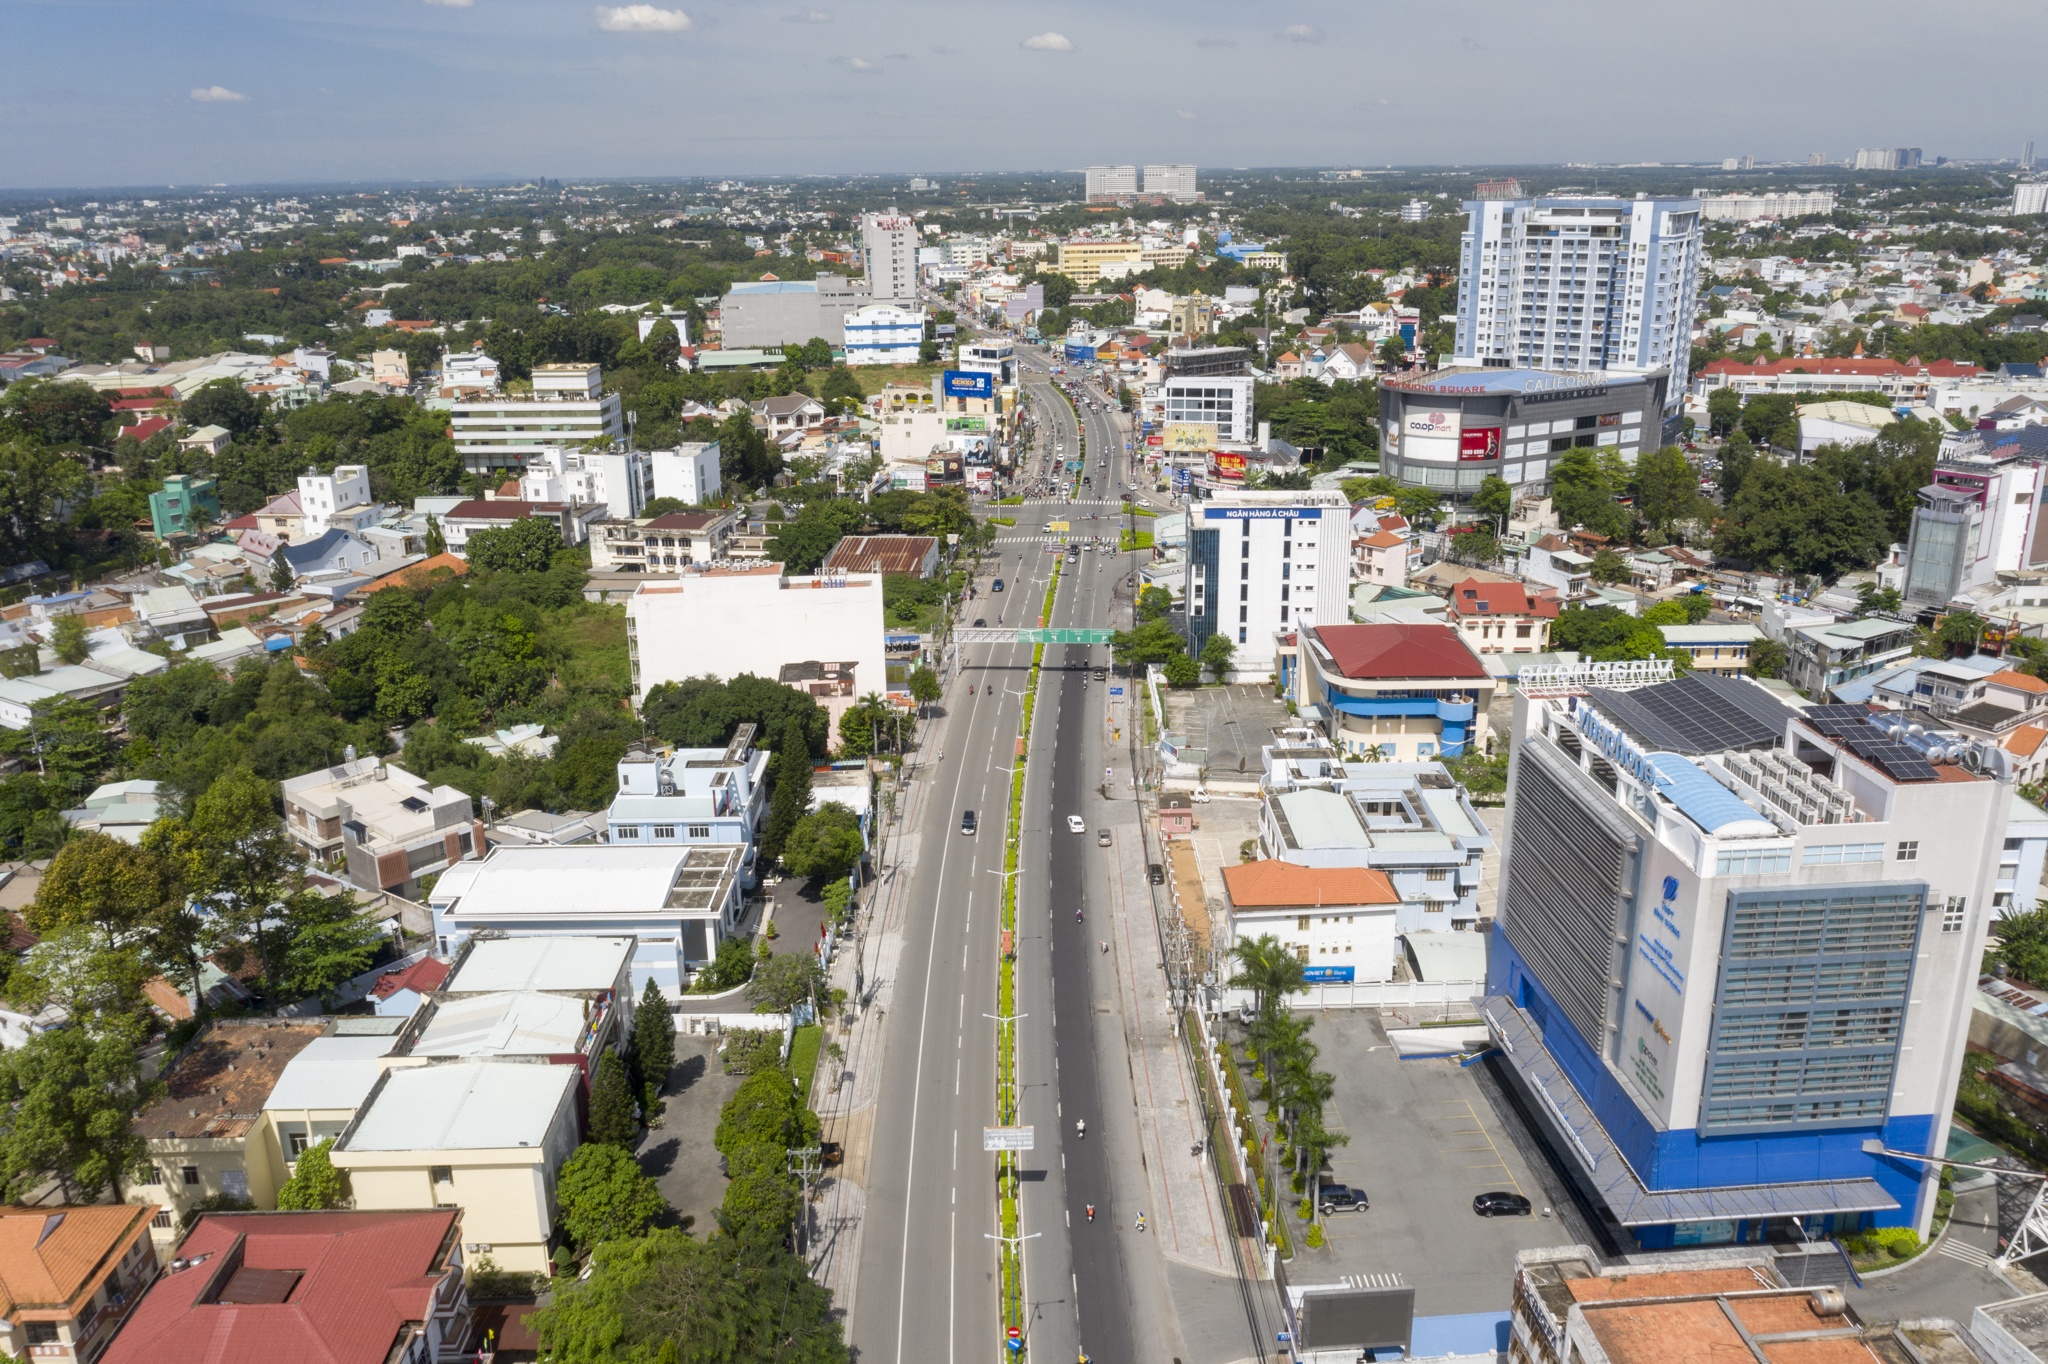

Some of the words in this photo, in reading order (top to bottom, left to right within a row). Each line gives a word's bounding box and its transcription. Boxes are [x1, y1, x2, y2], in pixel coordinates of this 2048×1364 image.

[1525, 372, 1608, 392] CALIFORNIA
[1440, 385, 1486, 393] SQUARE
[1226, 509, 1248, 517] NGÂN
[1272, 509, 1277, 517] Á
[1278, 509, 1299, 517] CHÂU
[823, 579, 846, 588] SHB
[1578, 706, 1657, 787] vinaphone
